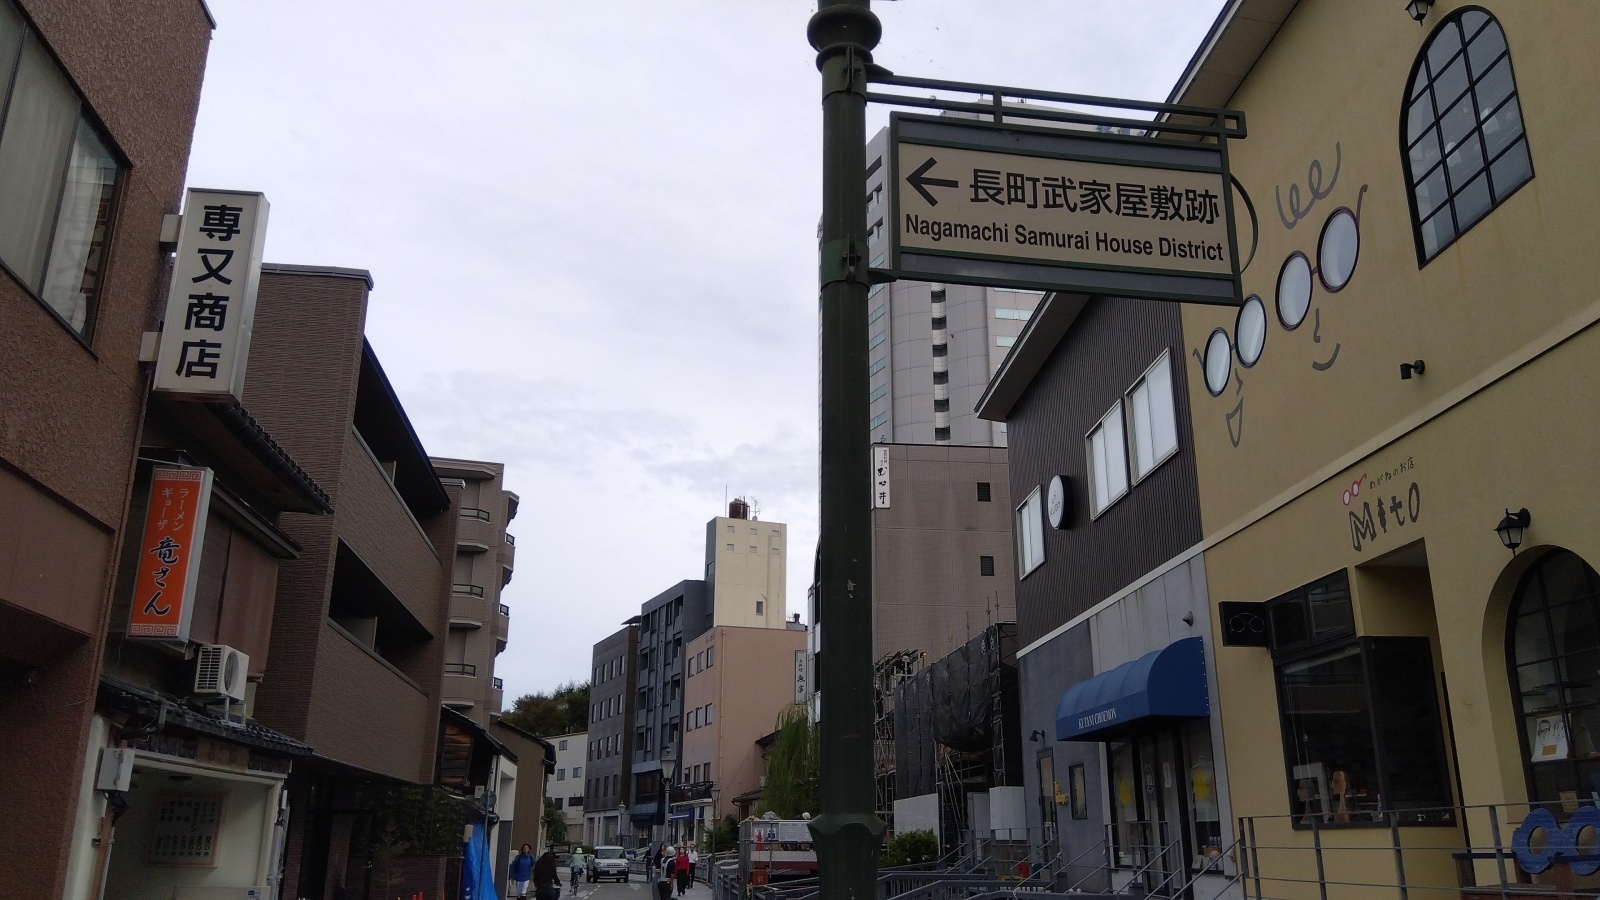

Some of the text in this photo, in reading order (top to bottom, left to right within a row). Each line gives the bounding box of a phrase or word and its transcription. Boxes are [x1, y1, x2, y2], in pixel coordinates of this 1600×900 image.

[969, 168, 1220, 225] 長町武家屋敷跡
[905, 213, 1224, 261] Nagamachi Samurai House District
[175, 204, 243, 379] 専又商店
[156, 487, 174, 531] ギョーザ
[173, 488, 190, 531] ラーメン
[143, 535, 182, 617] 竜さん
